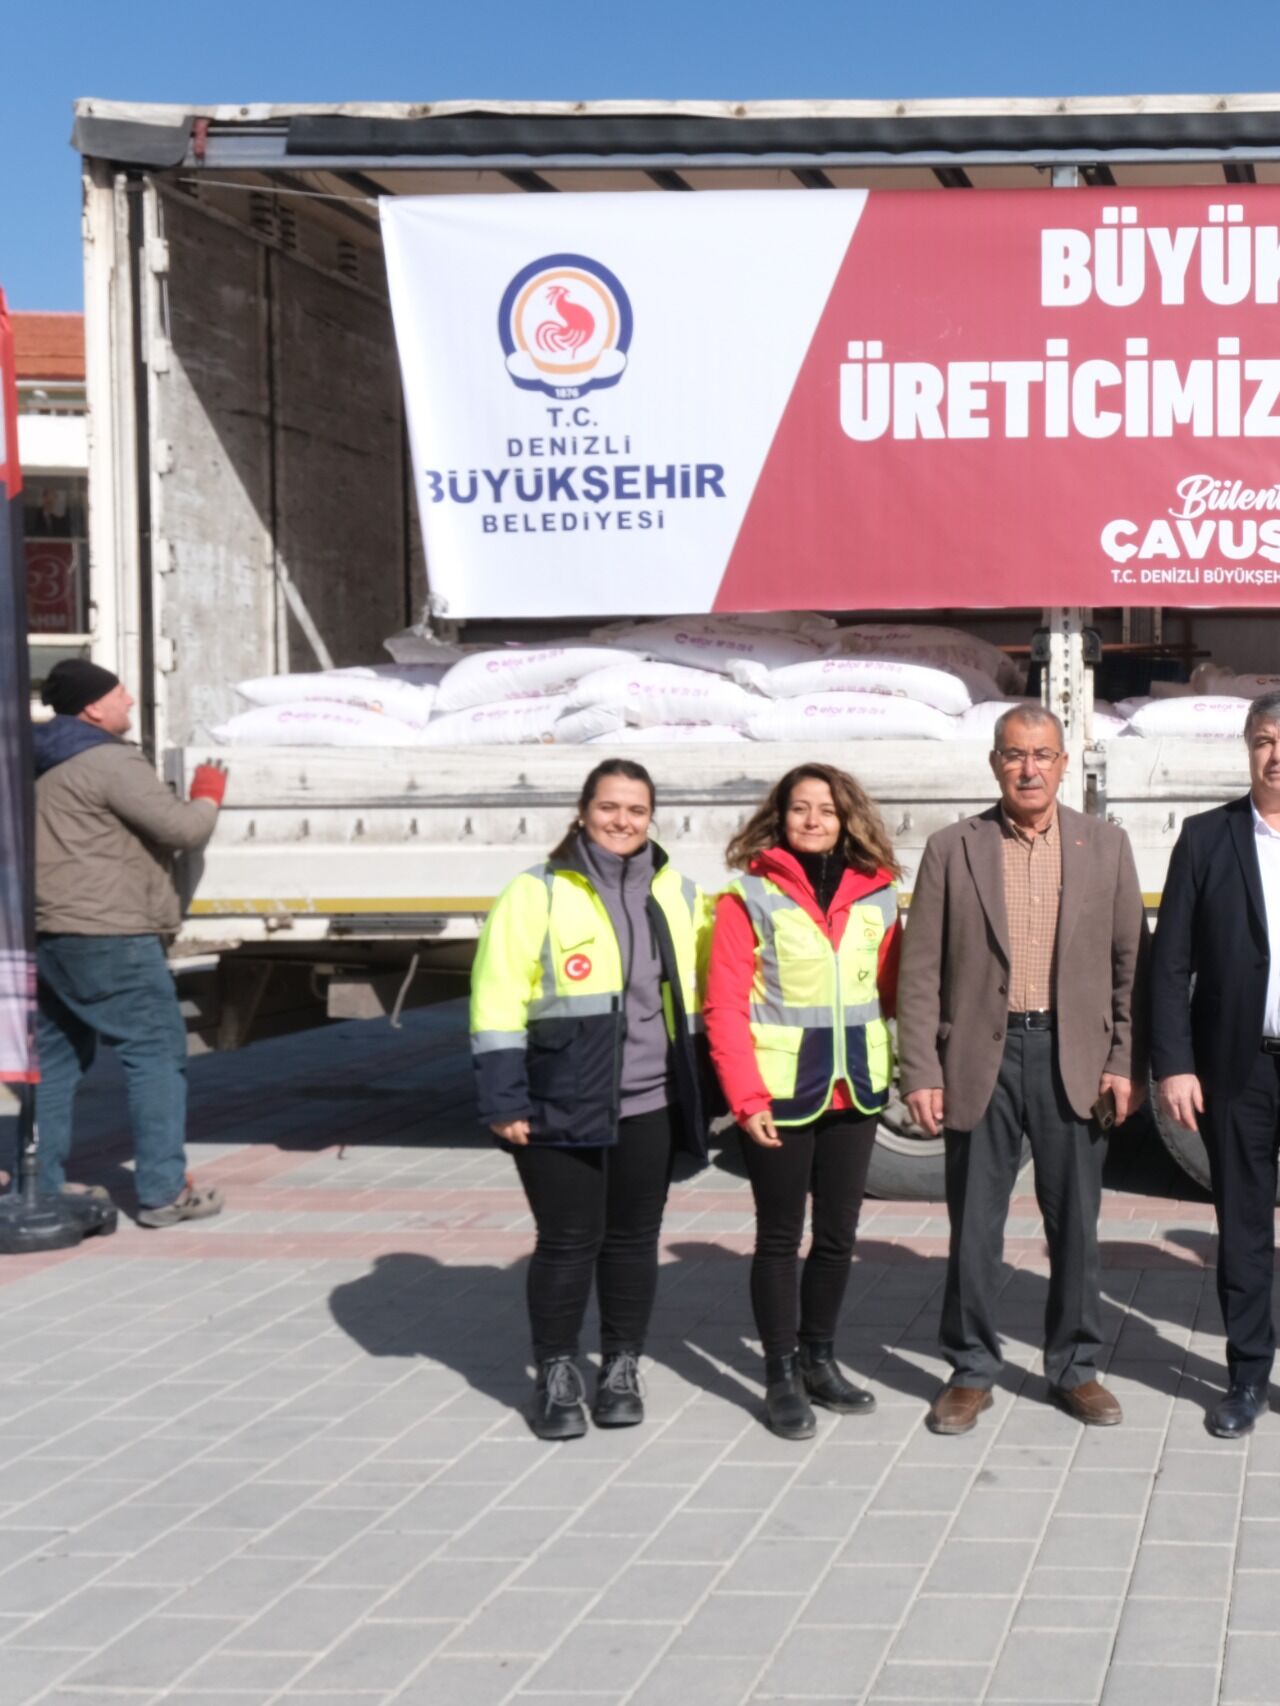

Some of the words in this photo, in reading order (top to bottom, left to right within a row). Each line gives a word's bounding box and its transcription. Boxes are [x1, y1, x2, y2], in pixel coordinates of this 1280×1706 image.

[546, 407, 598, 427] T.C.
[507, 436, 631, 457] DENİZLİ
[482, 510, 664, 533] BELEDİYESİ
[1111, 569, 1137, 583] T.C.
[1141, 566, 1200, 584] DENİZLİ
